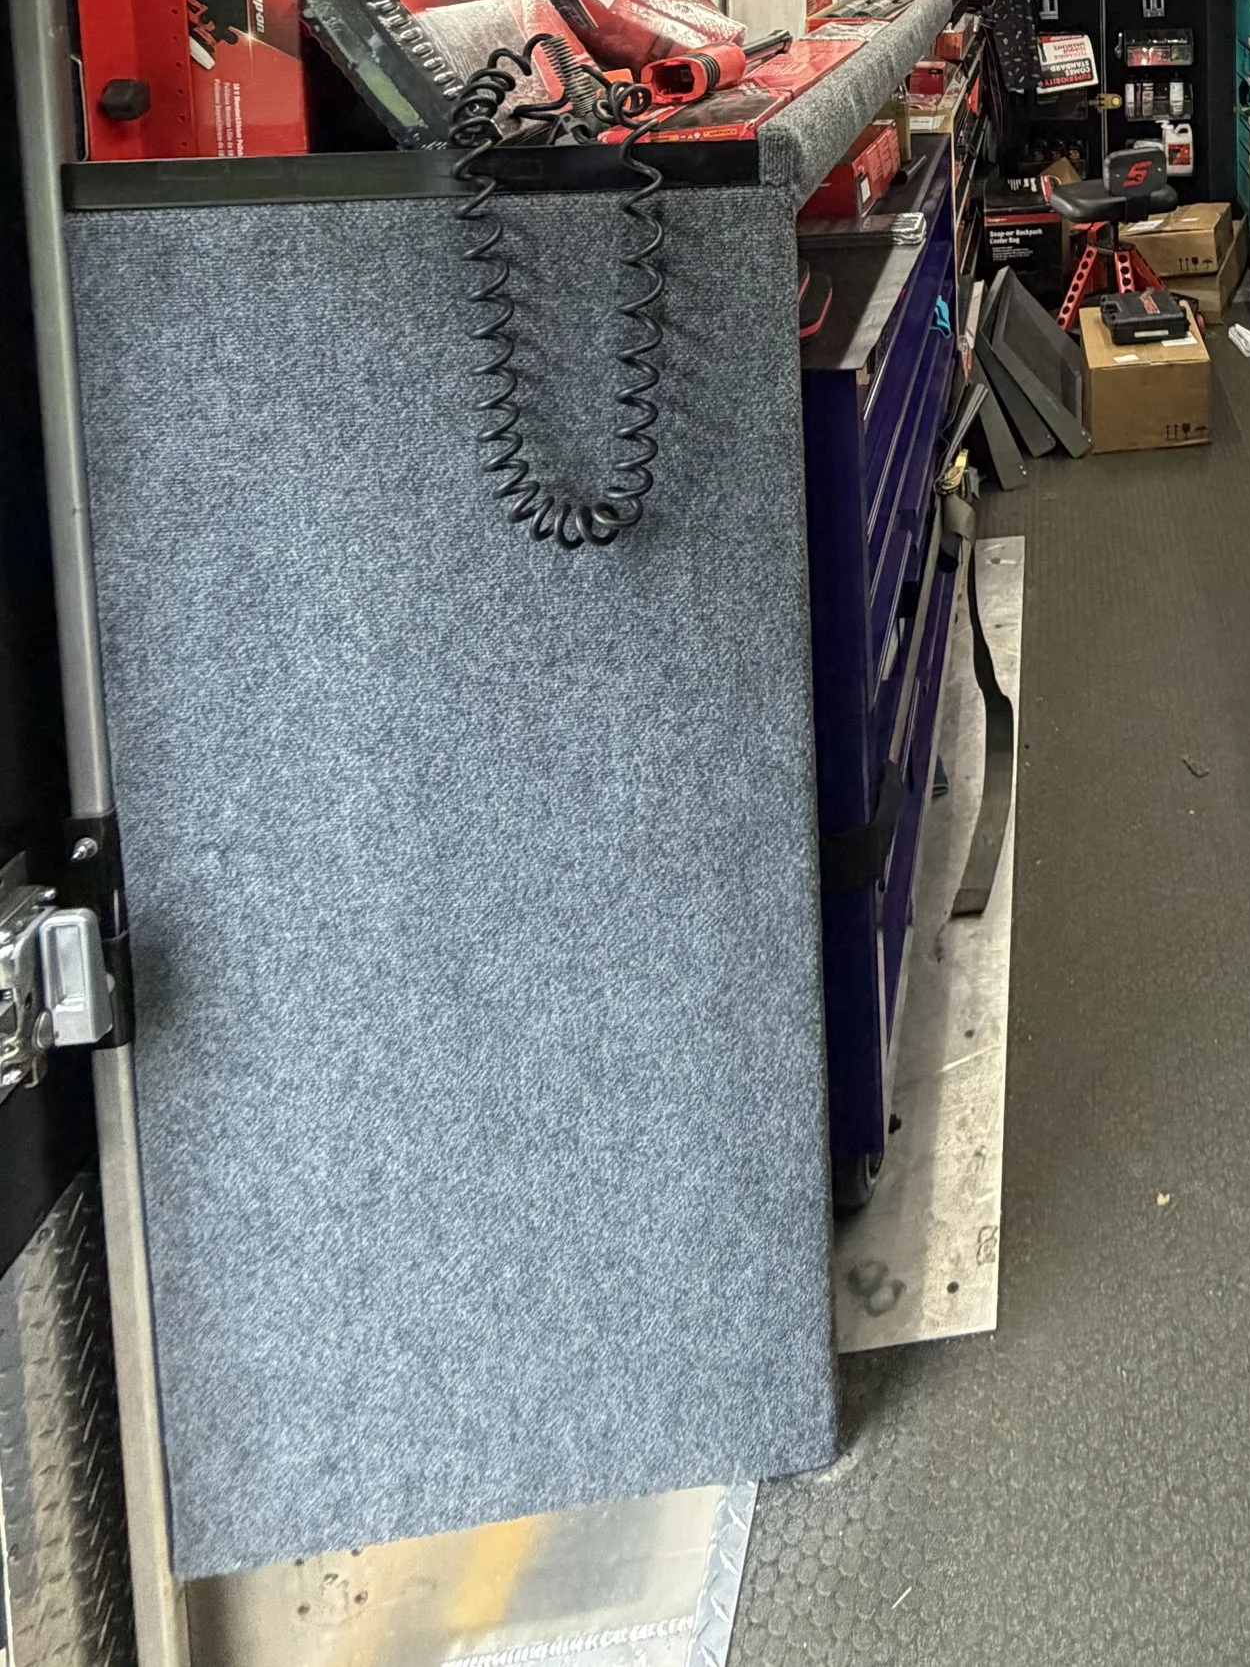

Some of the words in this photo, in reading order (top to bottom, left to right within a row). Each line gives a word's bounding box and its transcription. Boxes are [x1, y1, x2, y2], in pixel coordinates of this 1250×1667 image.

[1050, 60, 1090, 72] STANDARD
[1065, 67, 1091, 76] COMES
[1044, 74, 1092, 86] SUPERIORITY
[1016, 228, 1043, 237] Backpack
[1008, 237, 1020, 245] Bag
